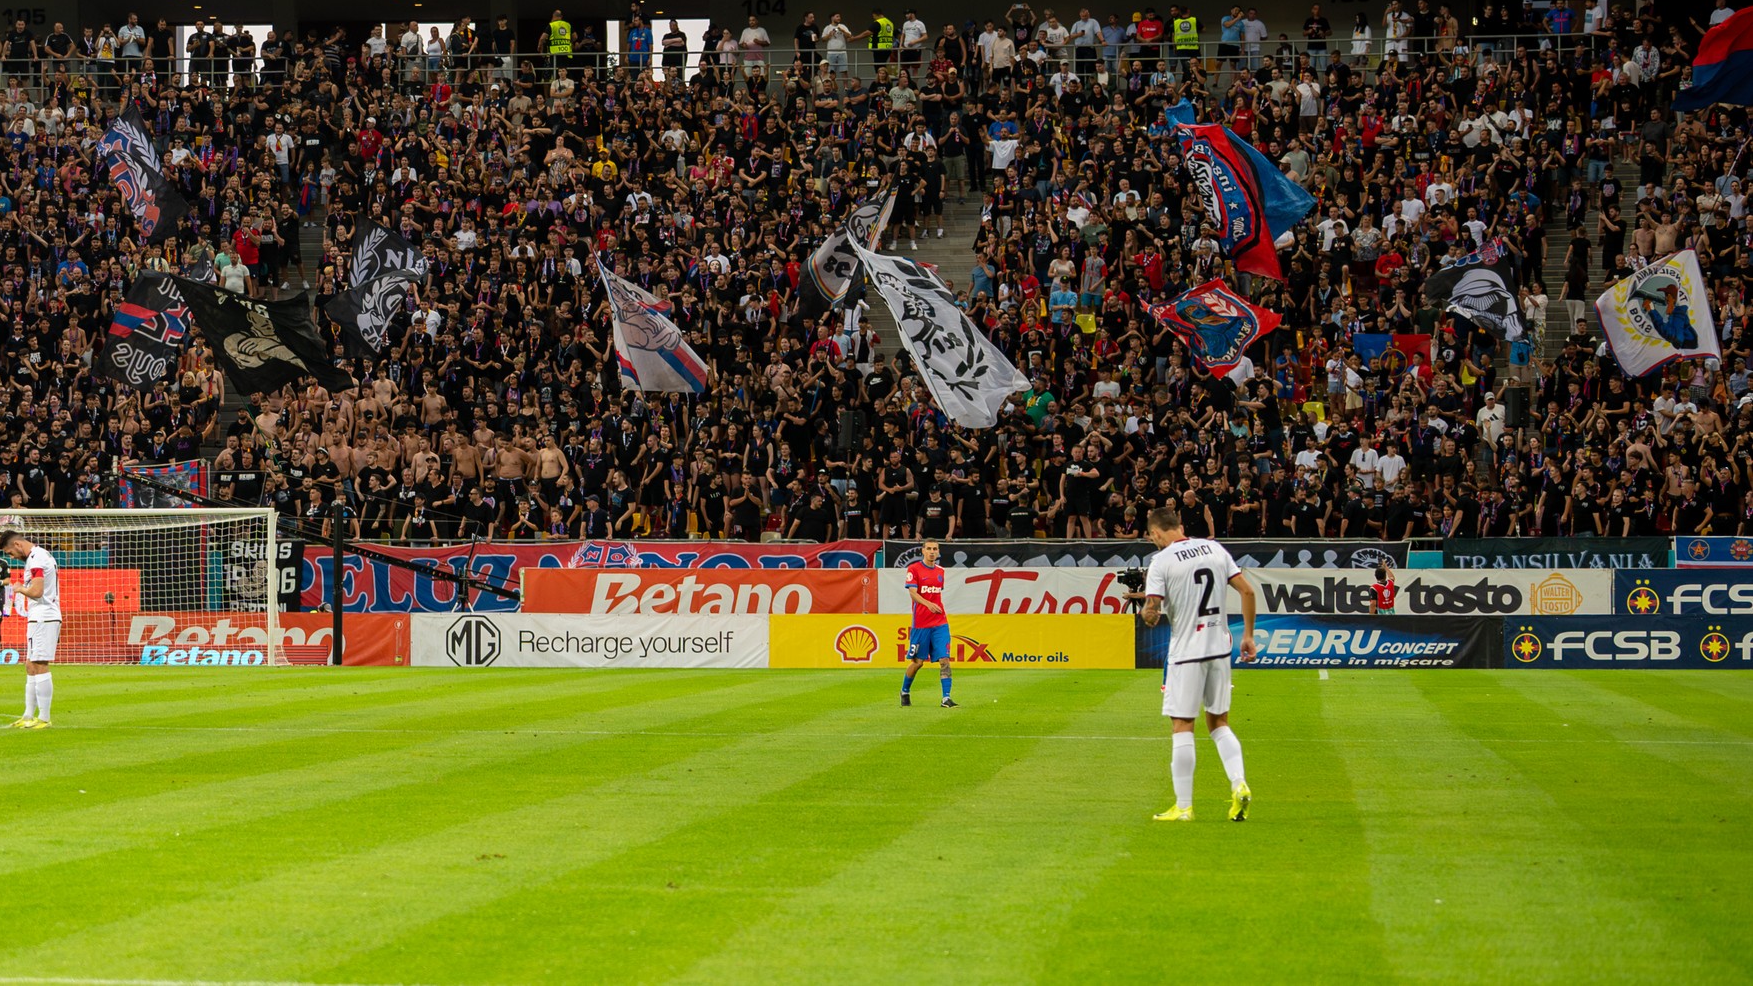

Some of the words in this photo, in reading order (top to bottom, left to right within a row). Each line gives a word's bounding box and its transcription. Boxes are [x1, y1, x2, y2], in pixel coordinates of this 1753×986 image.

[2, 8, 47, 25] 105
[590, 572, 813, 614] Betano
[920, 585, 943, 594] Betan
[1194, 568, 1220, 617] 2
[1261, 576, 1398, 614] walte
[1404, 576, 1522, 614] tosto
[1542, 587, 1572, 599] WALTER
[1666, 583, 1753, 614] FCS
[1542, 601, 1570, 611] TOSTO
[450, 620, 498, 665] MG
[518, 629, 633, 659] Recharge
[639, 630, 735, 659] yourself
[1378, 642, 1459, 655] CONCEPT
[1546, 630, 1682, 660] FCSB
[140, 645, 264, 666] Betano
[1001, 651, 1042, 662] Motor
[1045, 651, 1069, 662] oils
[1347, 655, 1368, 665] în
